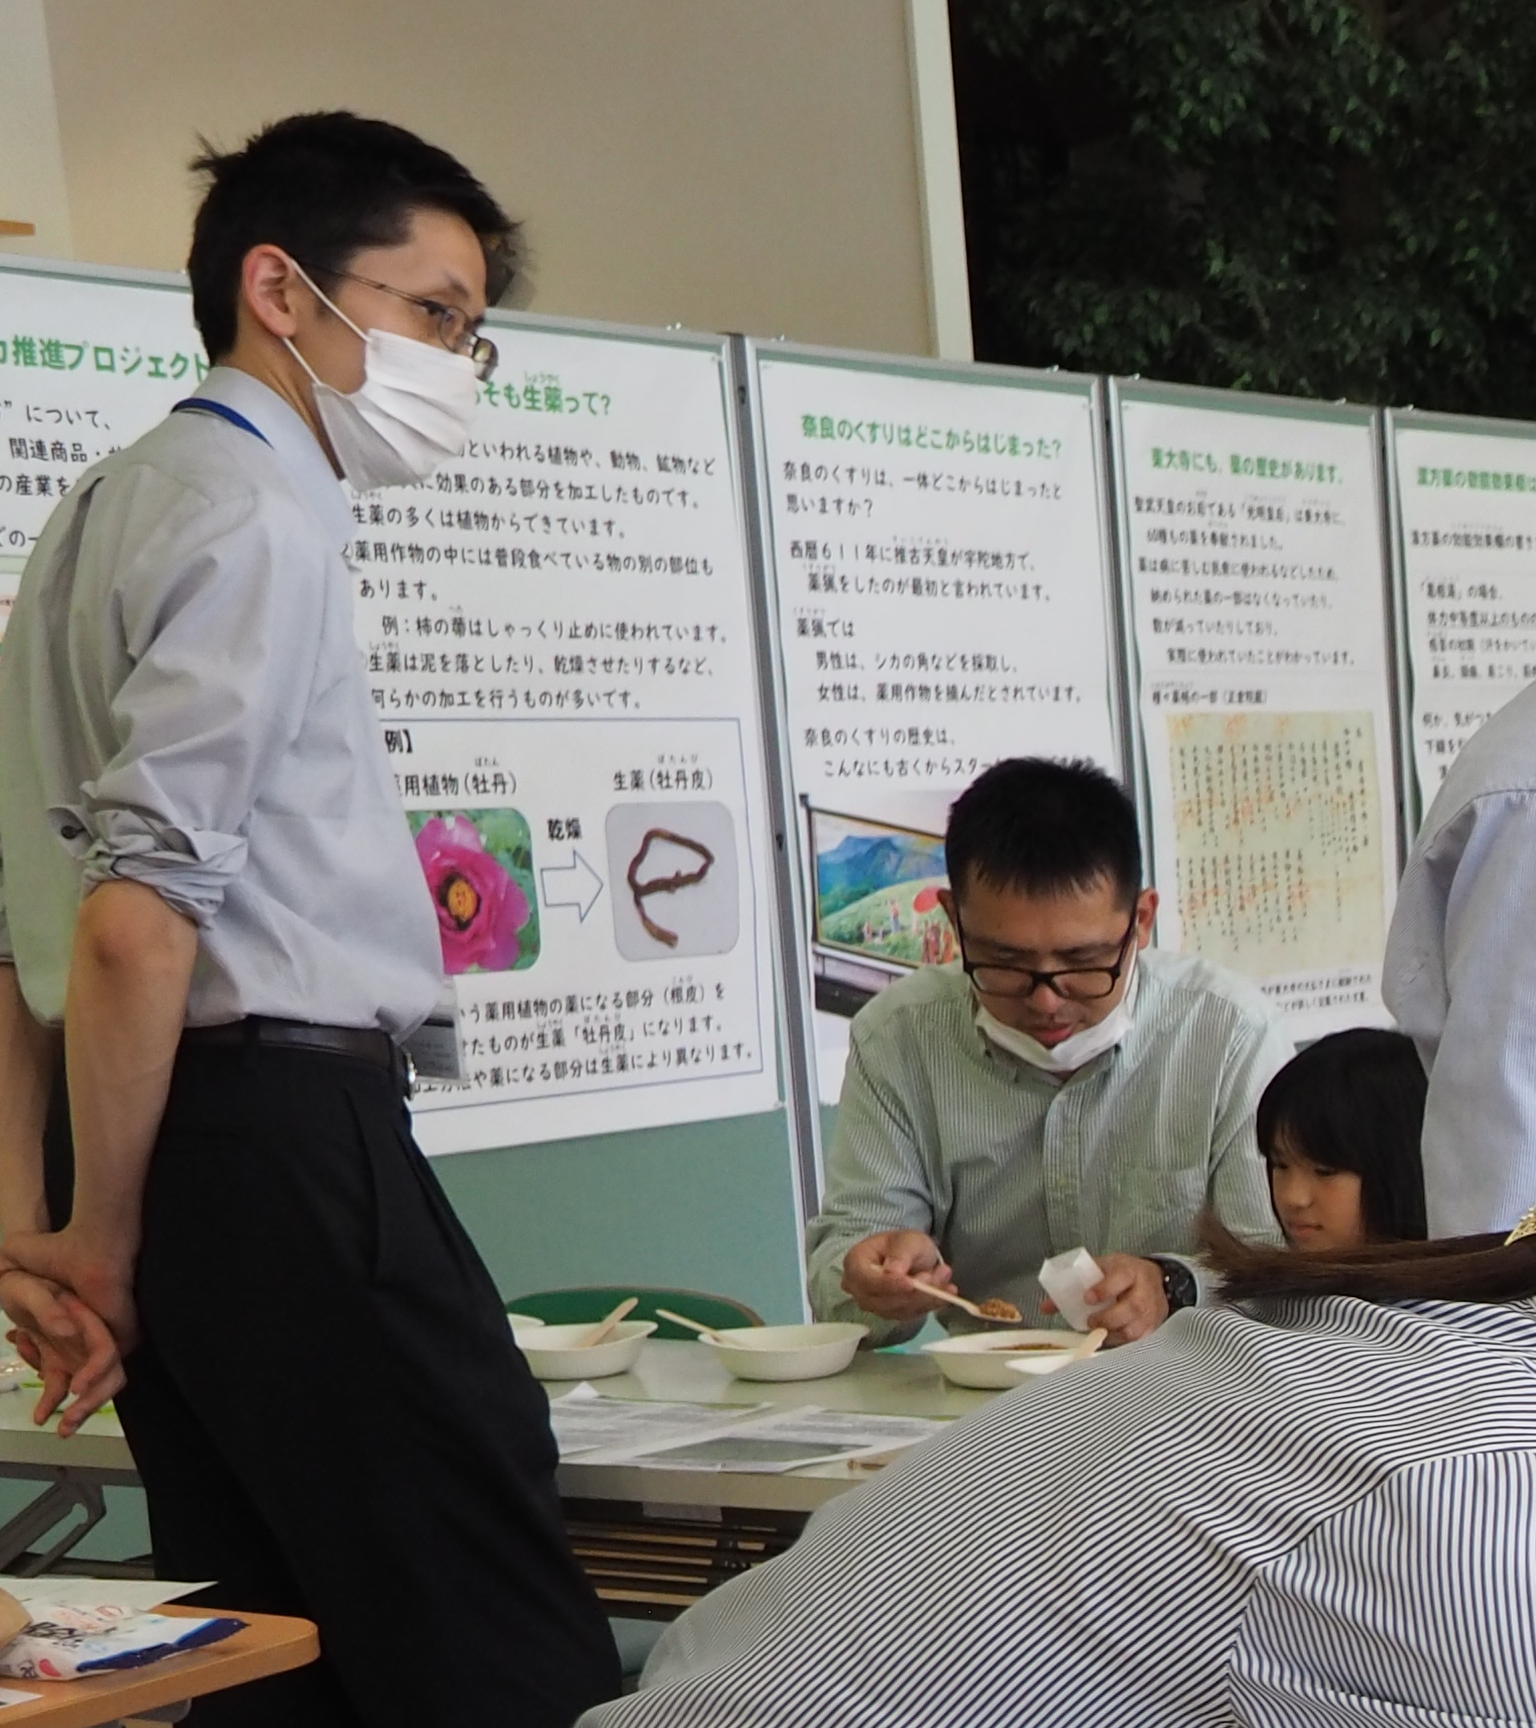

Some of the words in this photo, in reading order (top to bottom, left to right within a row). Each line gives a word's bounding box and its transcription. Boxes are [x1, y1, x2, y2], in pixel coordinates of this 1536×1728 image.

[459, 440, 716, 477] といわれる植物や、動物、鉱物など
[785, 494, 875, 520] 思いますか？
[359, 578, 438, 601] あります。
[547, 818, 582, 841] 乾燥
